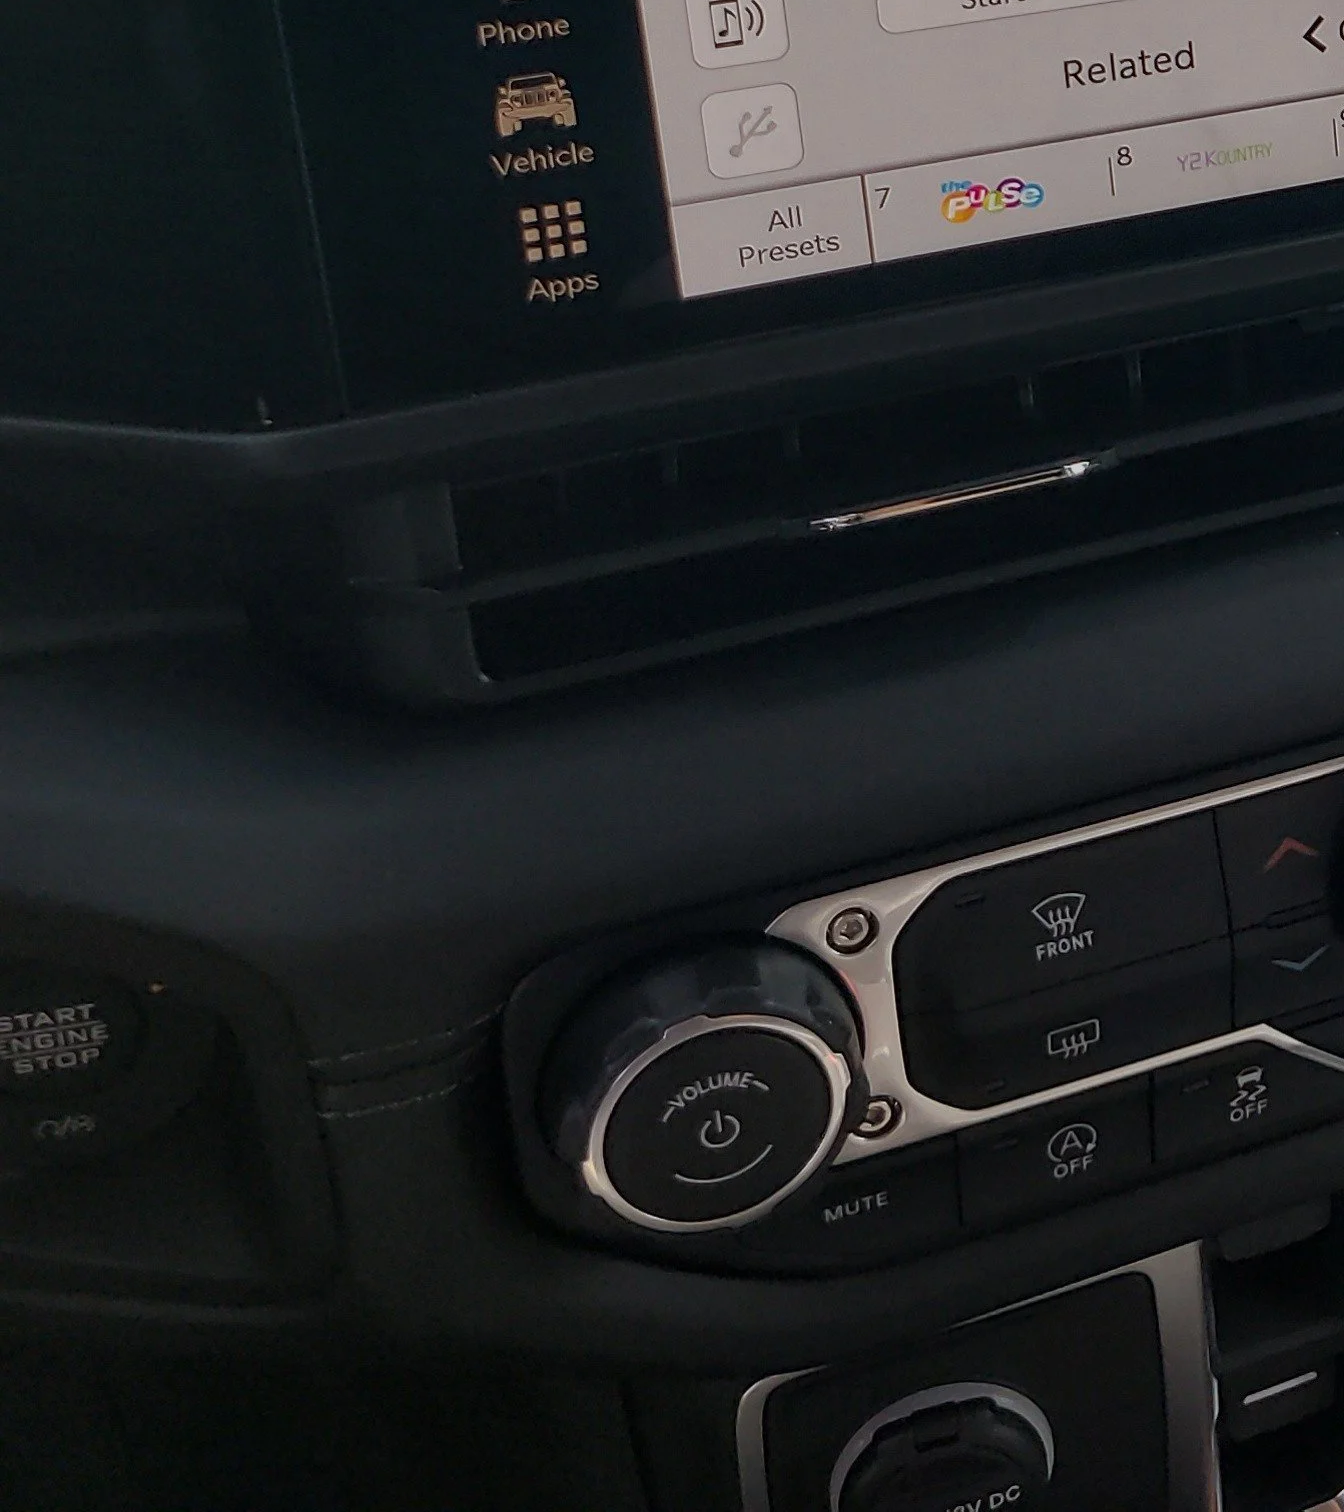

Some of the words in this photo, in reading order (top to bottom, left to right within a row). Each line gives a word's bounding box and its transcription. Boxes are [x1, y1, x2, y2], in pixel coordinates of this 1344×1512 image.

[475, 14, 571, 48] Phone
[1062, 42, 1195, 89] Related
[490, 141, 595, 178] Vehicle
[1116, 145, 1132, 167] 8
[876, 186, 892, 211] 7
[767, 205, 803, 232] All
[738, 233, 841, 269] Presets
[526, 269, 600, 305] Apps
[1036, 930, 1095, 961] FRONT
[0, 1003, 97, 1033] START
[13, 1047, 101, 1075] STOP
[670, 1069, 754, 1112] VOLUME
[1229, 1099, 1268, 1123] OFF
[1054, 1155, 1095, 1180] OFF
[823, 1190, 889, 1223] MUTE
[989, 1484, 1021, 1510] DC
